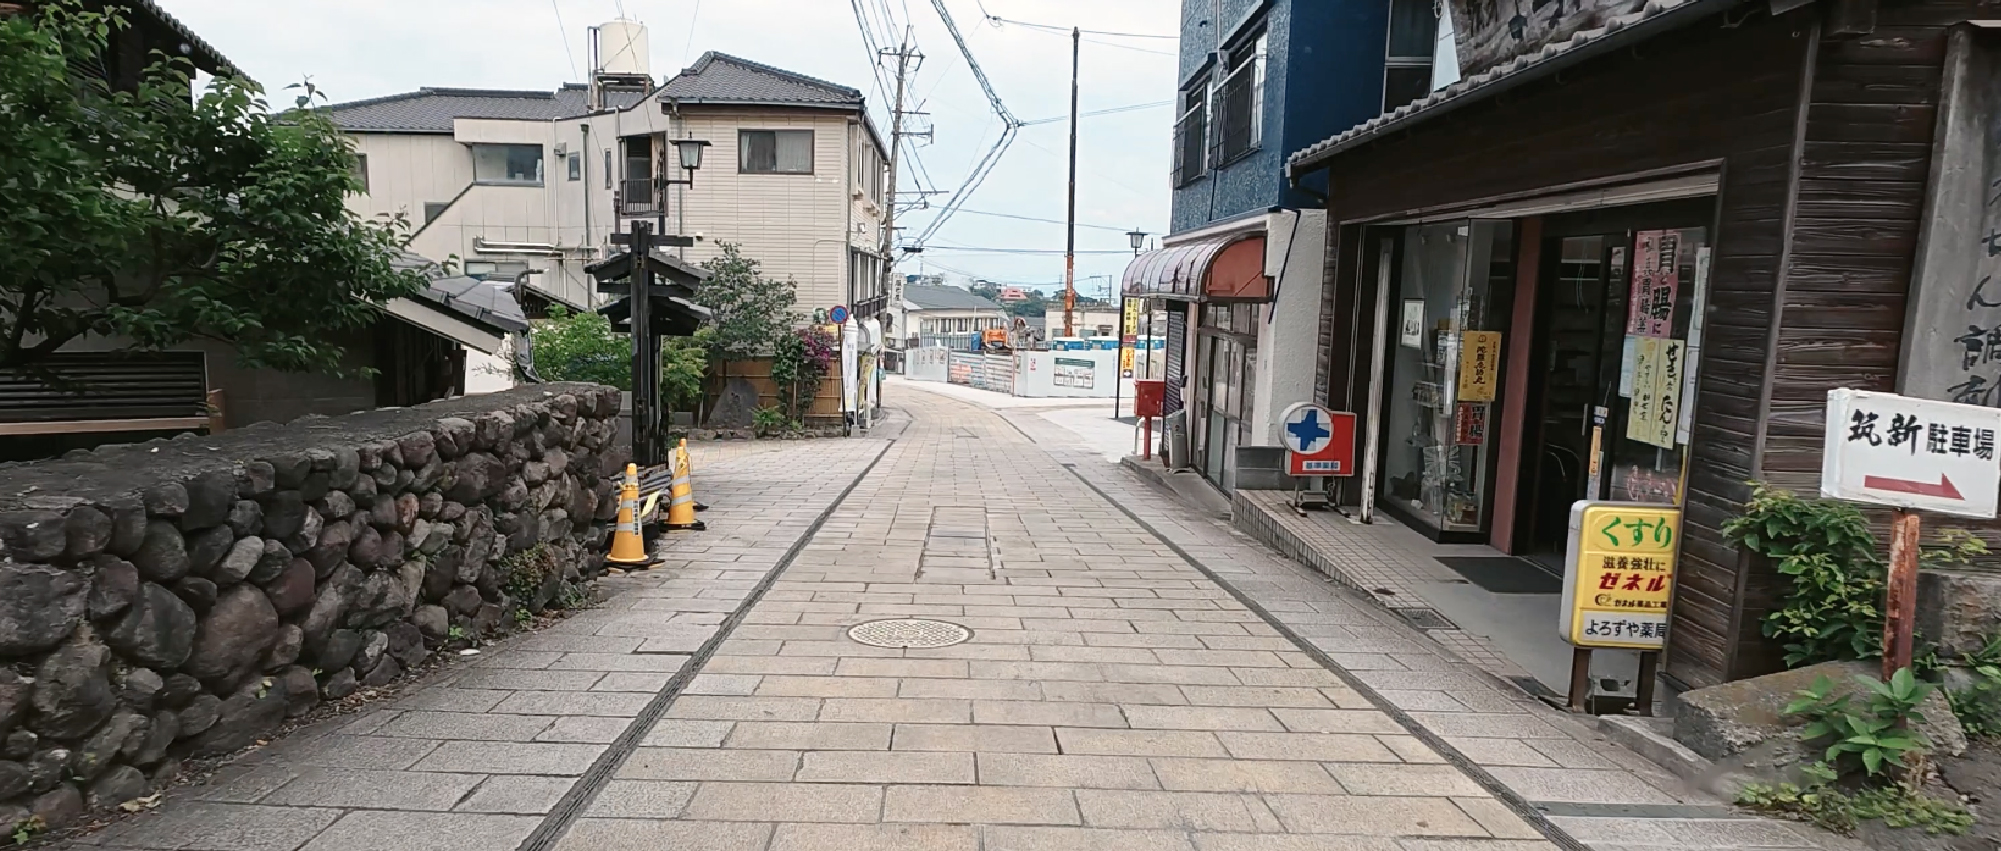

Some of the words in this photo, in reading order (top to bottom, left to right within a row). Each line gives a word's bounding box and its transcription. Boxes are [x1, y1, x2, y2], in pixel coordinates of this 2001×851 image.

[1601, 517, 1672, 548] くすり
[1602, 556, 1666, 572] 滋養強壮に
[1585, 619, 1667, 638] よろずや薬局
